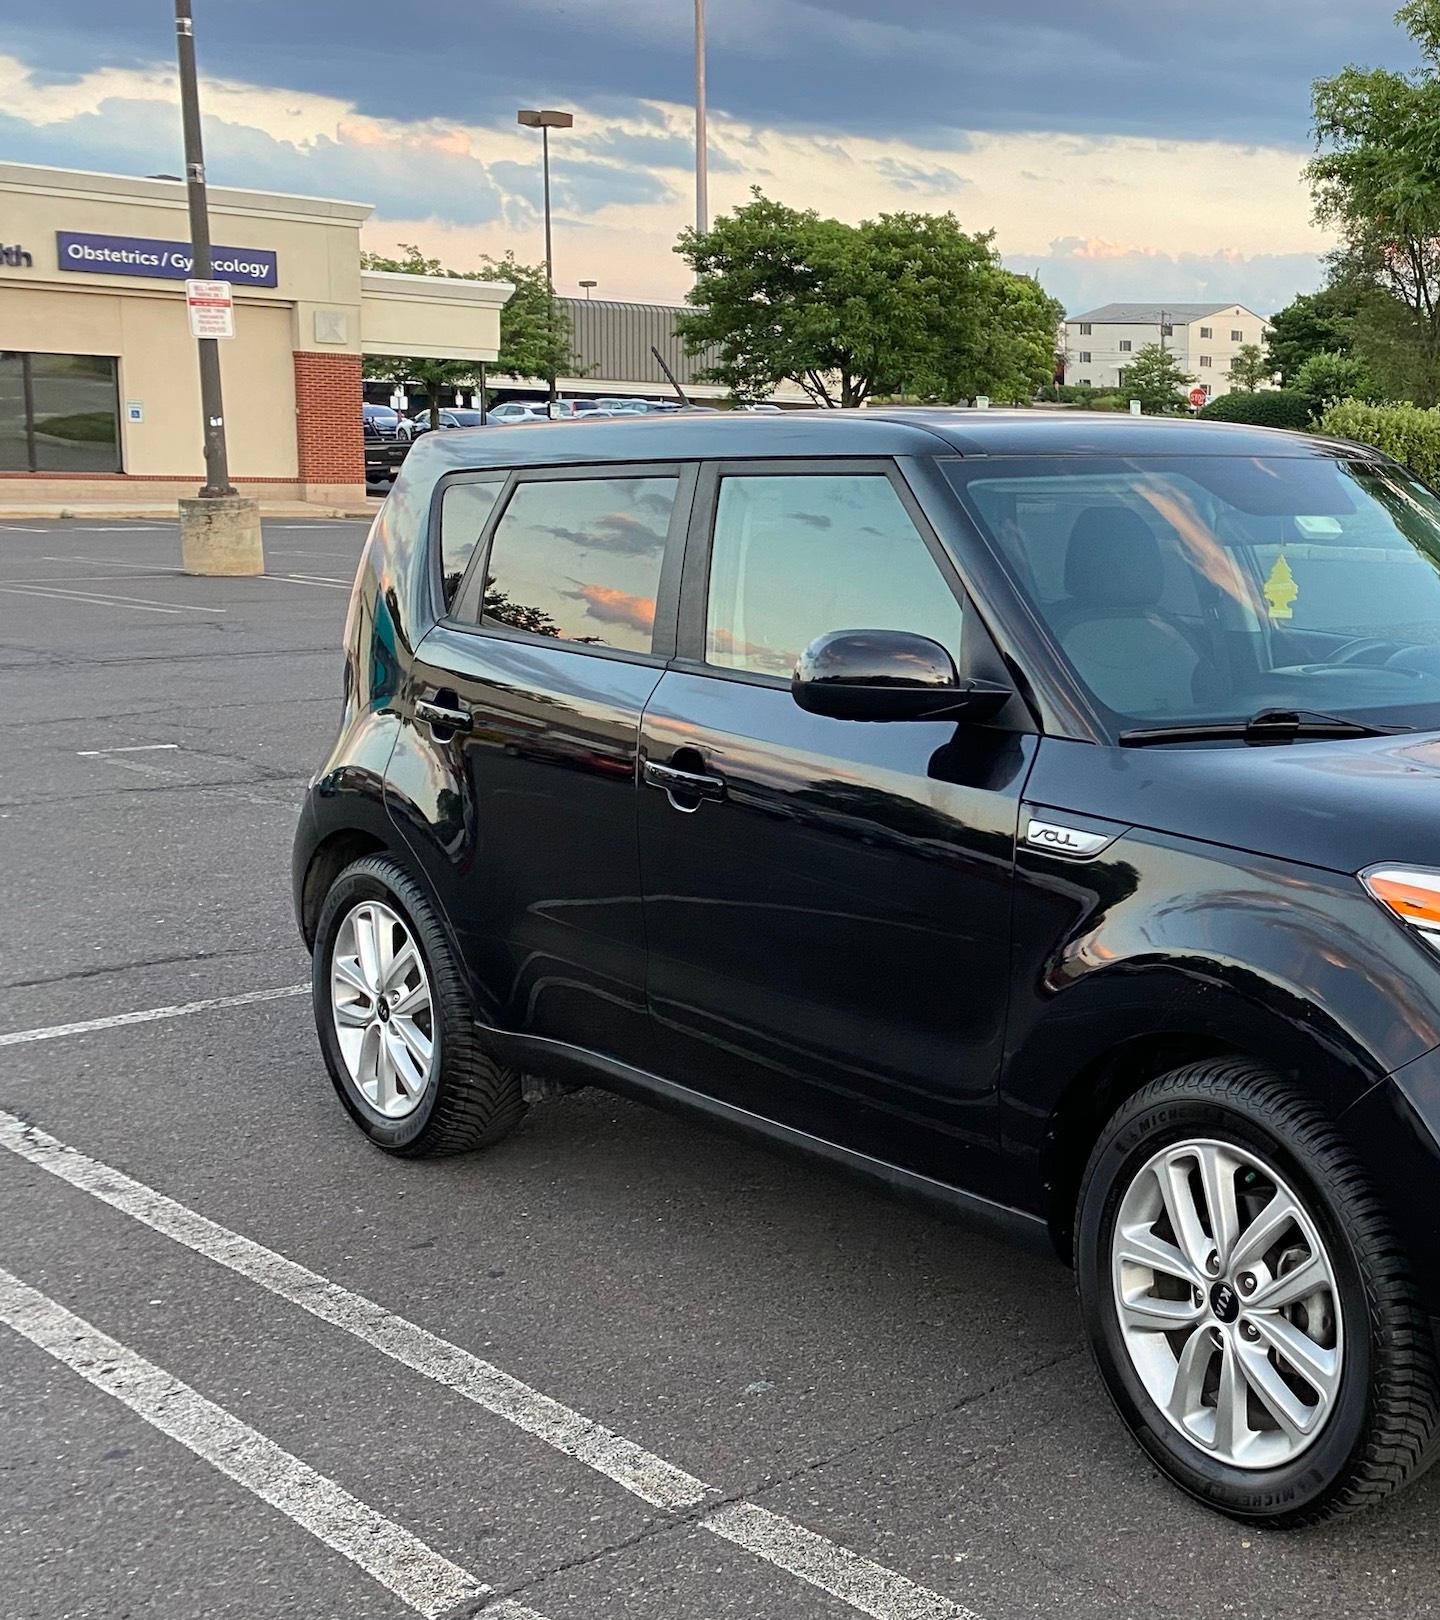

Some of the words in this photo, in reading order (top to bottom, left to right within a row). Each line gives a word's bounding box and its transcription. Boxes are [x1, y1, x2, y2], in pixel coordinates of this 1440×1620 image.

[67, 243, 159, 266] Obstetrics
[161, 252, 169, 267] /
[170, 253, 270, 278] Gycology
[1215, 1286, 1232, 1317] KIA
